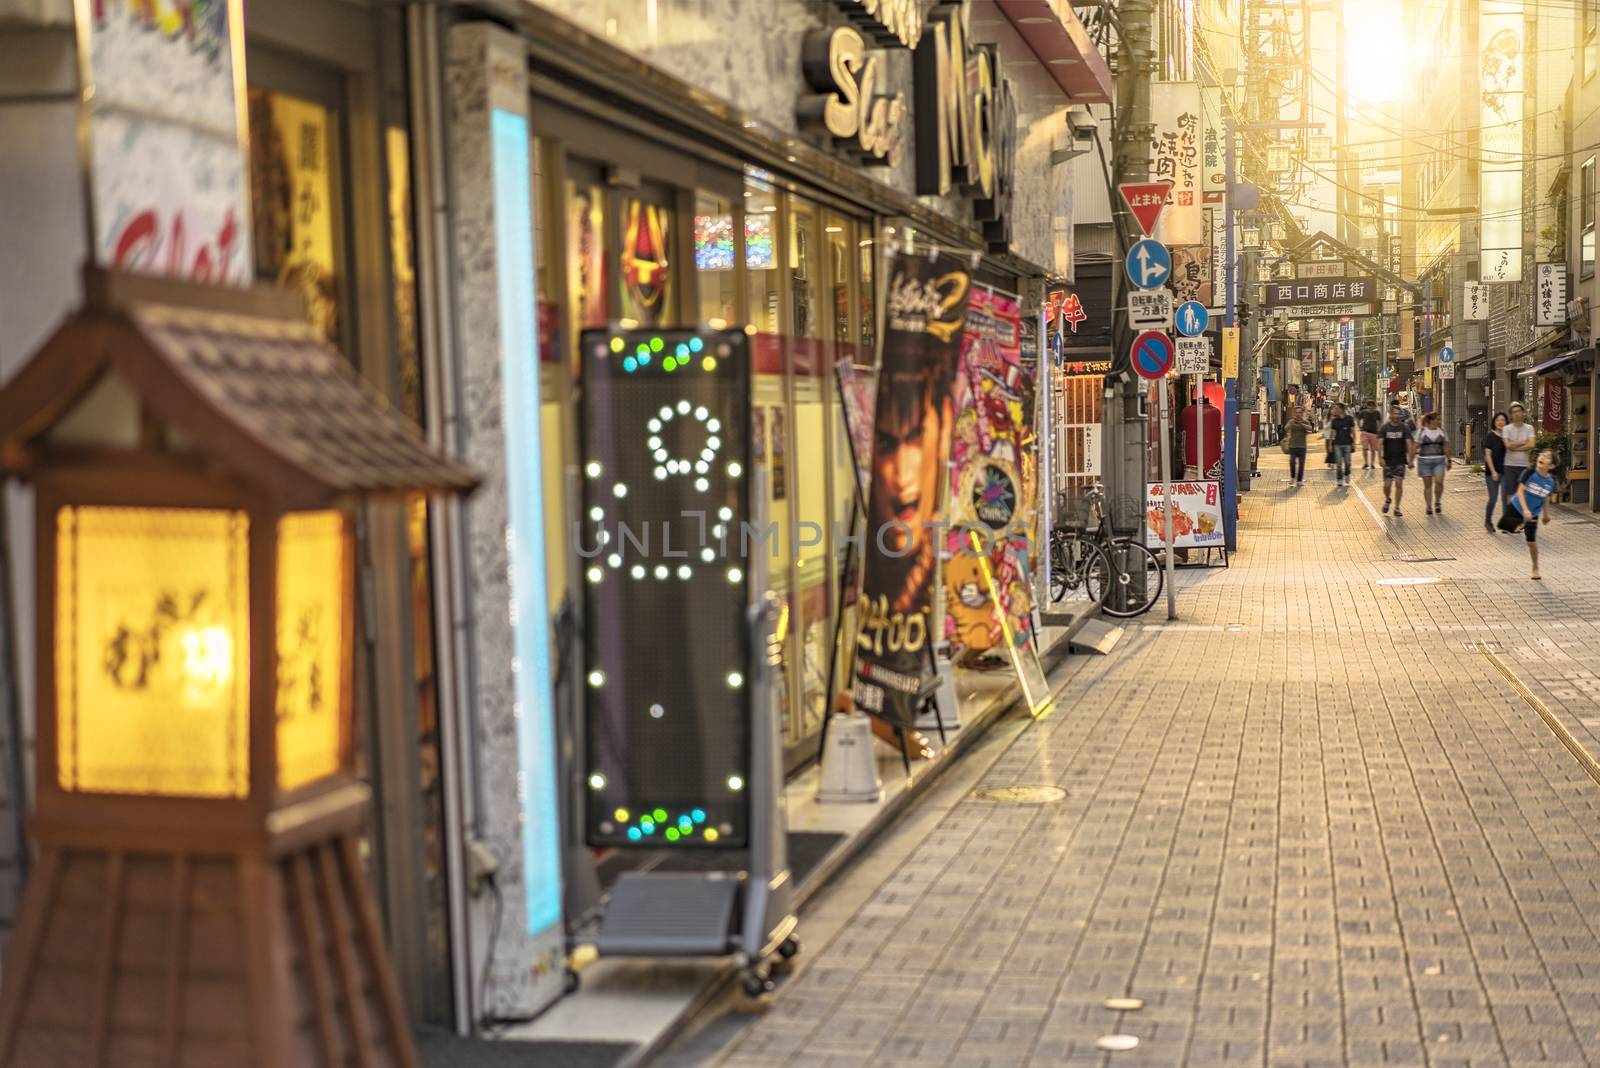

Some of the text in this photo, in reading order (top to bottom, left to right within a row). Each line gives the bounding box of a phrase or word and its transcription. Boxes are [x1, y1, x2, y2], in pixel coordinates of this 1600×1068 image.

[1132, 194, 1163, 207] 止まれ
[1494, 251, 1509, 279] このはな
[1278, 282, 1365, 301] 西口商店街
[1132, 306, 1170, 316] 一方通行
